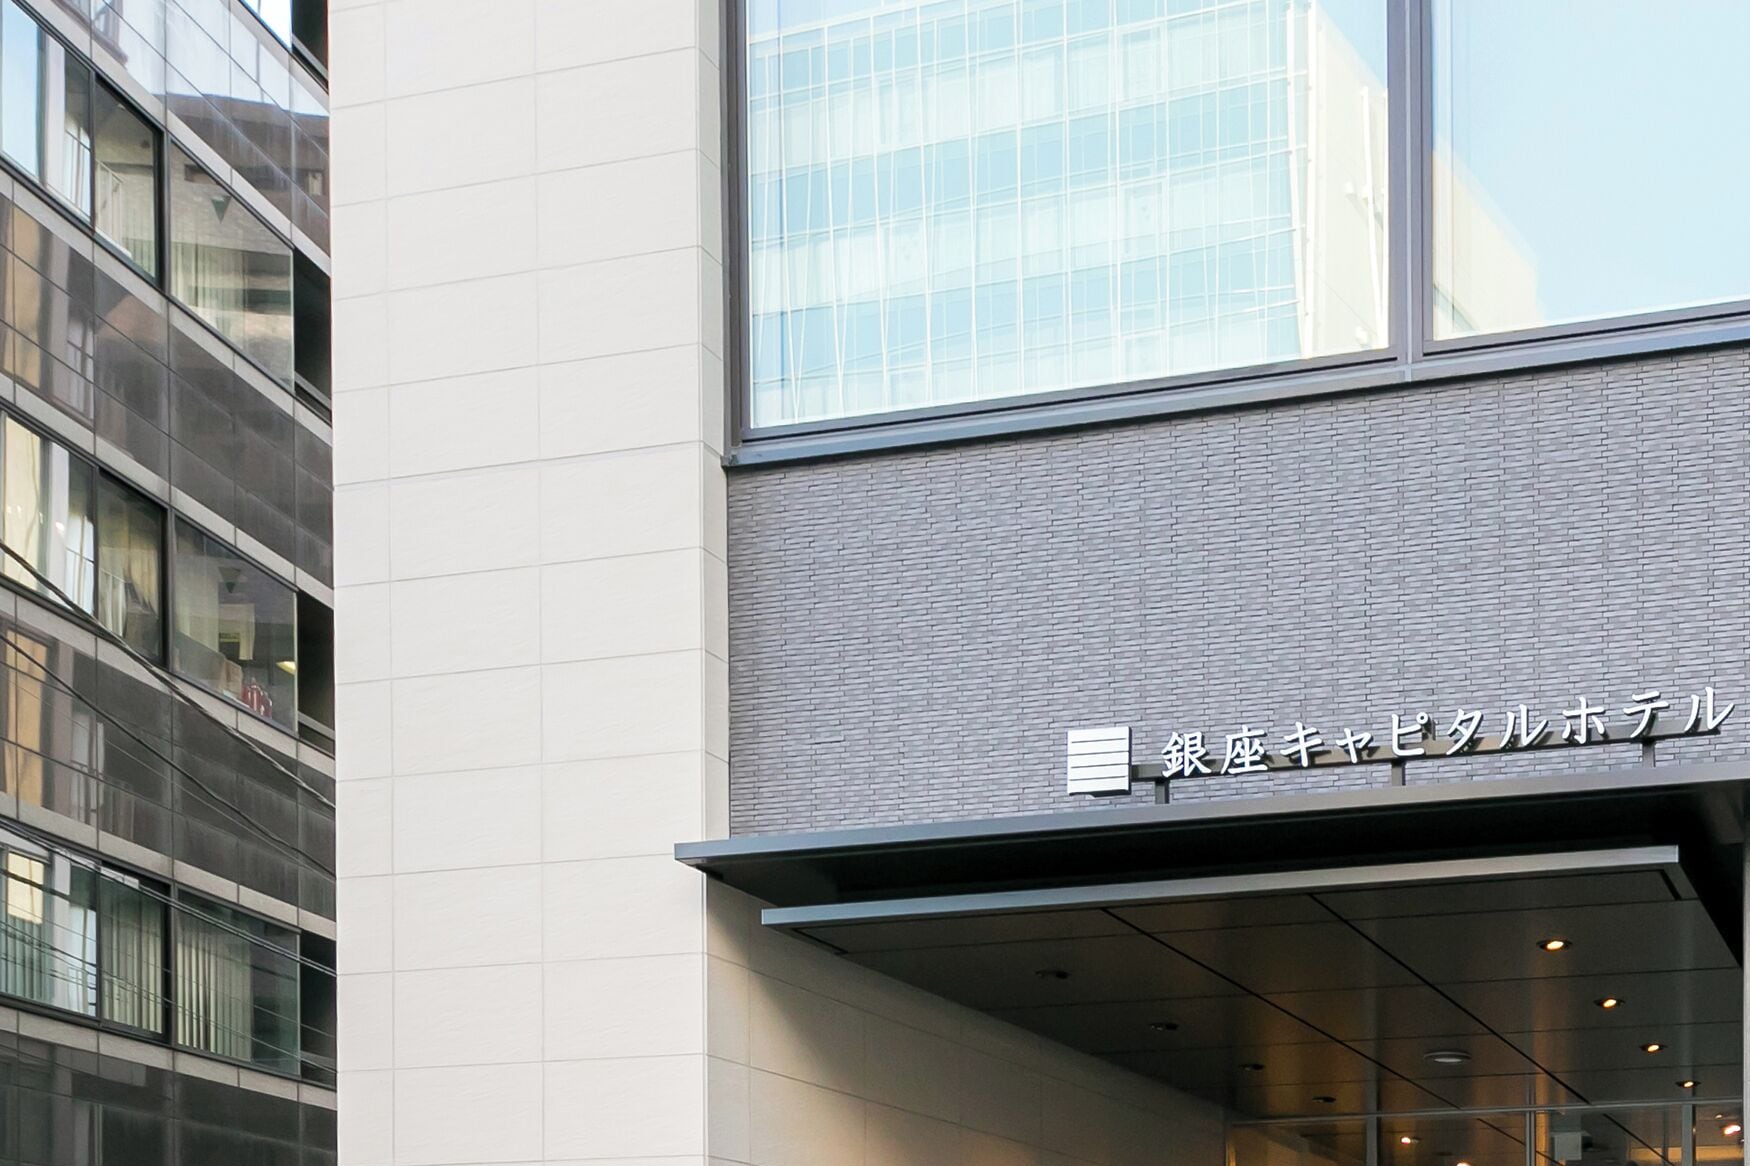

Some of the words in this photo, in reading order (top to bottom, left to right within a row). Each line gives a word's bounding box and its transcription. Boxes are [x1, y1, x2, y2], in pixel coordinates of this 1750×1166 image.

[1161, 687, 1735, 778] 銀座キャピタルホテル
